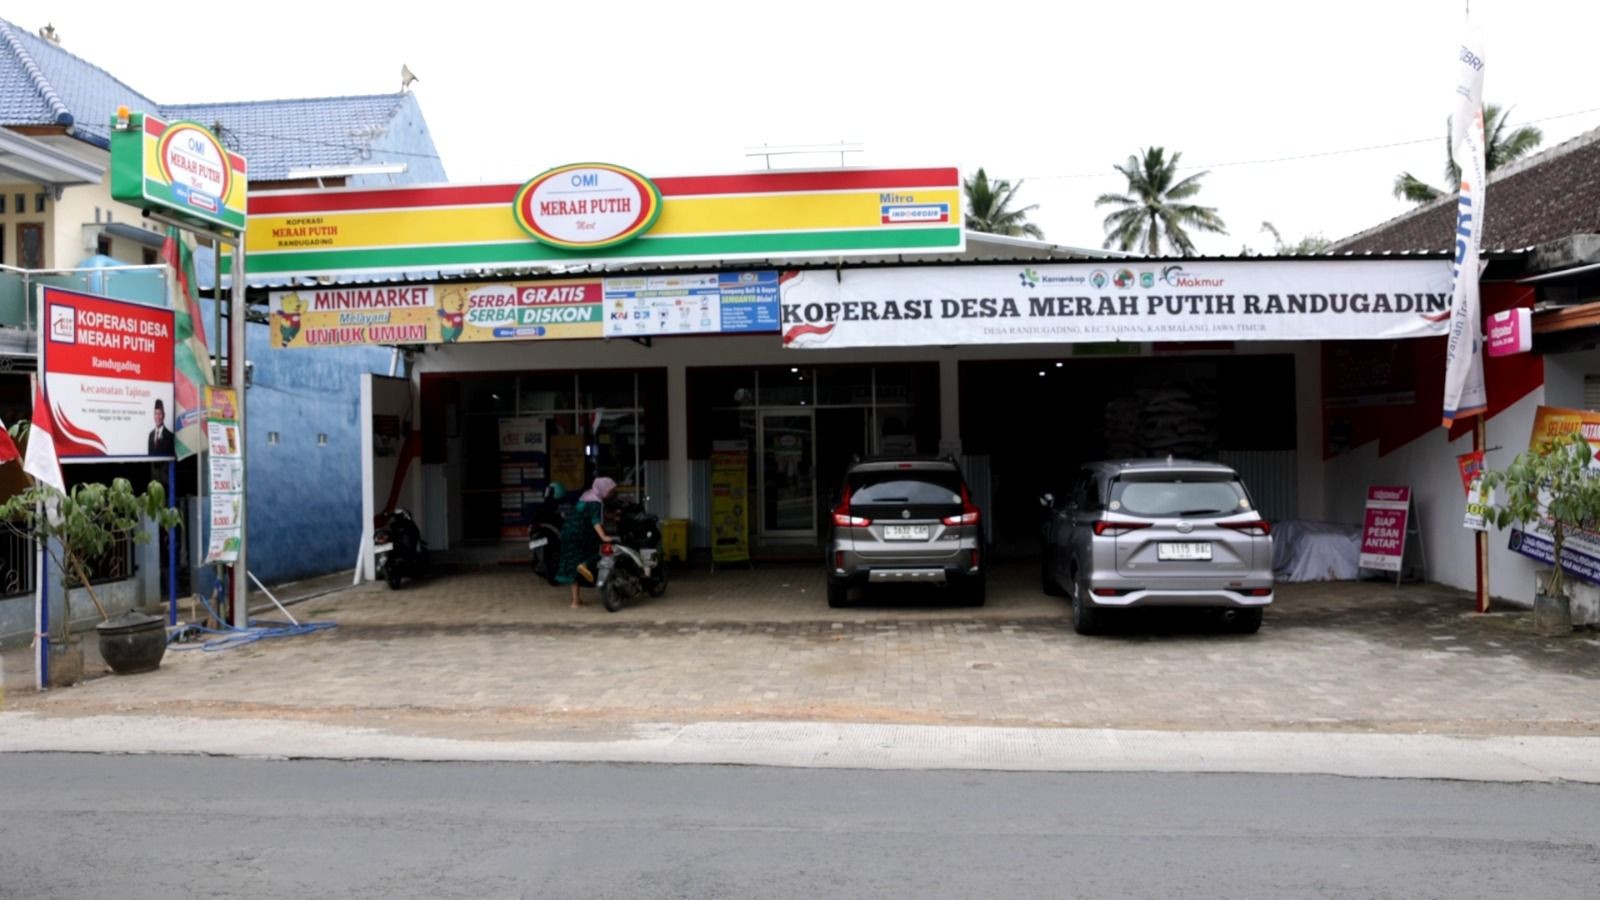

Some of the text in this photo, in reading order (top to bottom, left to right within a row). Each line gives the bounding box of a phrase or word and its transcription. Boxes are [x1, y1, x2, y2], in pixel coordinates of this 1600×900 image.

[188, 137, 206, 155] OMI
[170, 151, 221, 184] MERAH PUTIH
[571, 173, 598, 188] OMI
[880, 192, 914, 203] Mitra
[540, 197, 631, 216] MERAH PUTIH
[286, 217, 324, 226] KOPERASI
[272, 225, 338, 238] MERAH PUTIH
[278, 238, 334, 247] RANDUGADING
[1041, 273, 1085, 284] Kemenkop
[1175, 276, 1225, 288] Makmur
[314, 287, 429, 310] MINIMARKET
[469, 286, 586, 308] SERBA GRATIS
[468, 306, 593, 324] SERBA DISKON
[782, 300, 933, 324] KOPERASI
[941, 297, 1020, 319] DESA
[1028, 295, 1139, 318] MERAH
[1146, 294, 1236, 316] PUTIH
[1243, 291, 1453, 315] RANDUGADIN
[77, 309, 137, 333] KOPERASI
[139, 320, 169, 339] DESA
[339, 311, 391, 326] Melayani
[305, 324, 428, 345] UNTUK UMUM
[984, 326, 1007, 335] DESA
[1236, 323, 1266, 331] TIMUR
[77, 329, 156, 353] MERAH PUTIH
[91, 356, 141, 374] Randugading
[80, 383, 151, 399] Kecamatan Tajinan
[1374, 516, 1396, 527] SIAP
[1368, 527, 1399, 538] PESAN
